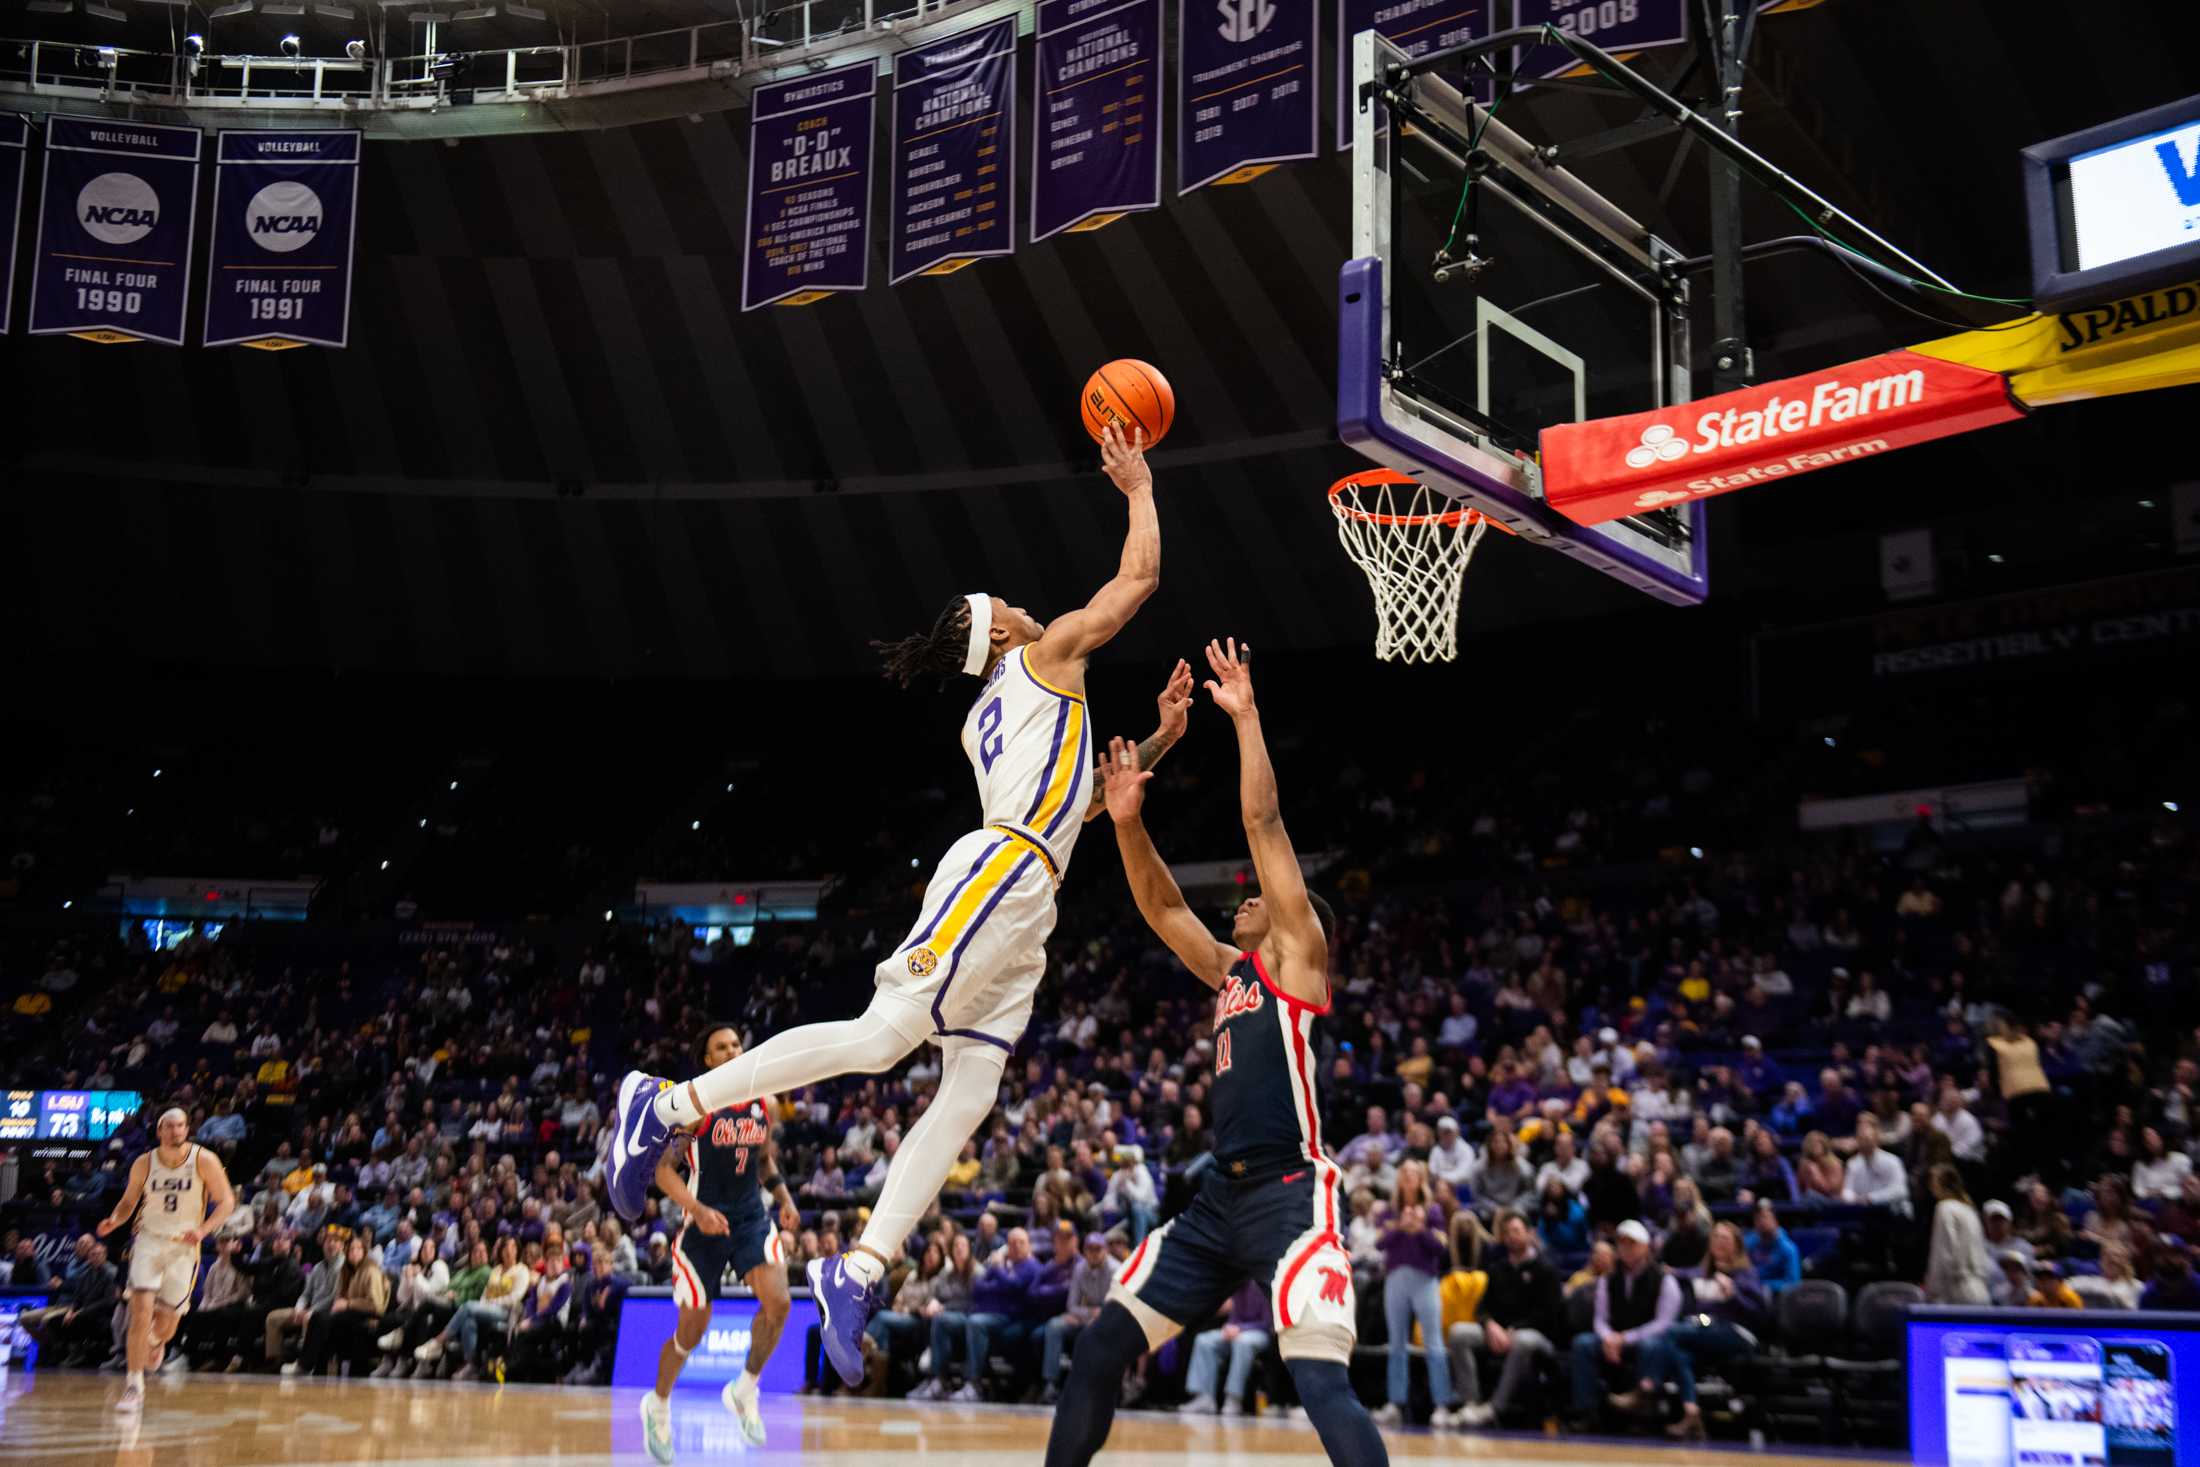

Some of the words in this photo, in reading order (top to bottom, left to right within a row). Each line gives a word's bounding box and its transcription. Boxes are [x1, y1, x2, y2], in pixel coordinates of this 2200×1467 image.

[1559, 0, 1639, 37] 2008
[1066, 29, 1131, 63] NATIONAL
[1250, 41, 1303, 65] CHAMPIONS
[1058, 42, 1139, 82] CHAMPIONS
[922, 82, 985, 113] NATIONAL
[915, 95, 992, 130] CHAMPIONS
[90, 130, 159, 146] VOLLEYBALL
[258, 142, 321, 153] VOLLEYBALL
[771, 146, 852, 182] BREAUX
[85, 205, 156, 228] NCAA
[253, 216, 320, 233] NCAA
[65, 268, 110, 286] FINAL
[115, 272, 158, 289] FOUR
[236, 279, 278, 294] FINAL
[282, 279, 322, 294] FOUR
[76, 287, 142, 314] 1990
[250, 298, 304, 320] 1991
[2059, 284, 2200, 352] SPALD
[978, 696, 1003, 776] 2
[48, 1096, 84, 1110] LSU
[49, 1113, 80, 1138] 73
[712, 1118, 738, 1145] Ole
[735, 1147, 749, 1174] 7
[152, 1178, 192, 1191] LSU
[164, 1194, 178, 1212] 9
